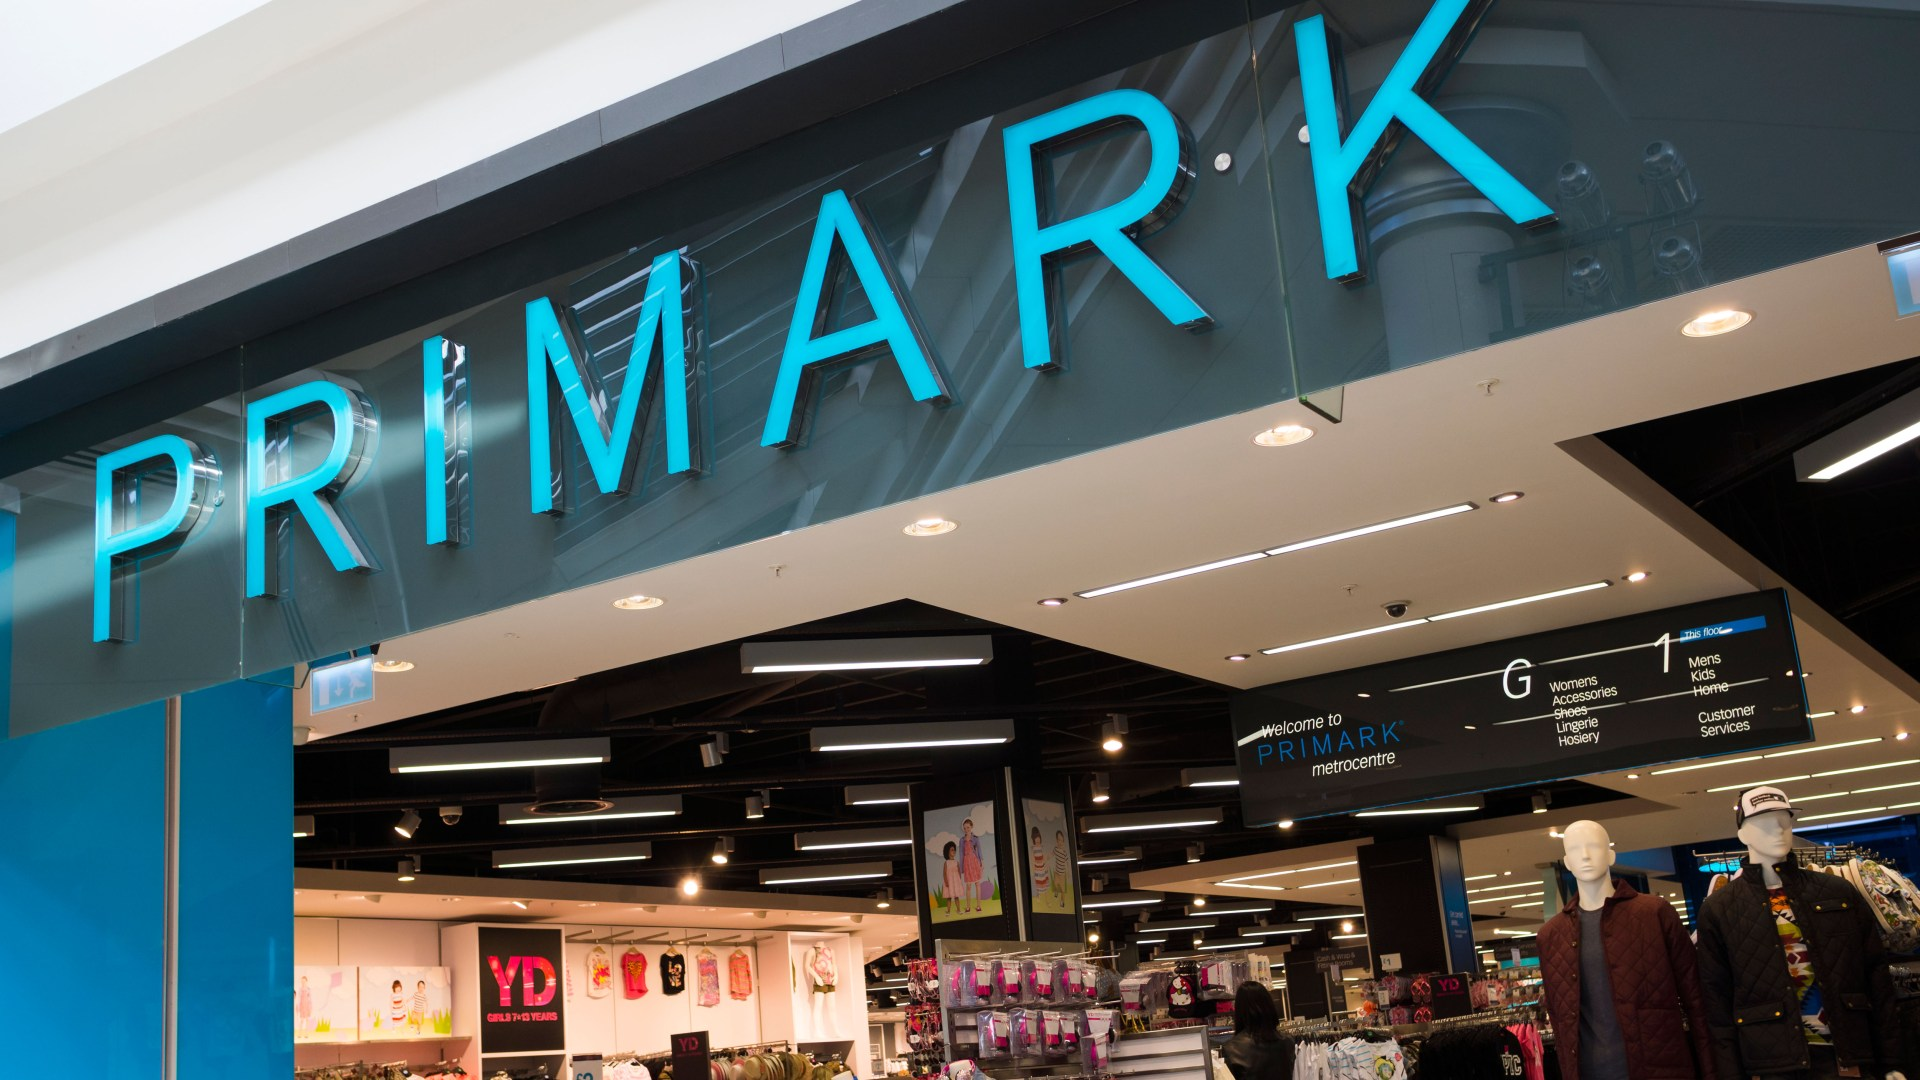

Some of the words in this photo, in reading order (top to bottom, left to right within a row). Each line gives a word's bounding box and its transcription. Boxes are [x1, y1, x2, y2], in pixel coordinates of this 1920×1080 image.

[93, 0, 1556, 642] PRIMARK
[1684, 630, 1701, 639] This
[1703, 626, 1723, 637] floor
[1654, 632, 1670, 673] 1
[1688, 654, 1722, 668] Mens
[1502, 658, 1532, 699] G
[1690, 668, 1716, 682] Kids
[1549, 676, 1598, 693] Womens
[1693, 682, 1729, 696] Home
[1552, 686, 1618, 706] Accessories
[1554, 705, 1588, 720] Shoes
[1698, 705, 1756, 723] Customer
[1261, 716, 1324, 739] Welcome
[1328, 713, 1342, 727] to
[1556, 717, 1599, 733] Lingerie
[1700, 720, 1751, 738] Services
[1257, 721, 1400, 766] PRIMARK
[1558, 731, 1600, 747] Hosiery
[1312, 752, 1396, 777] metrocentre
[486, 955, 557, 1007] YD
[1437, 978, 1460, 991] YD
[487, 1013, 512, 1023] GIRLS
[531, 1011, 558, 1021] YEARS
[678, 1036, 699, 1052] YD
